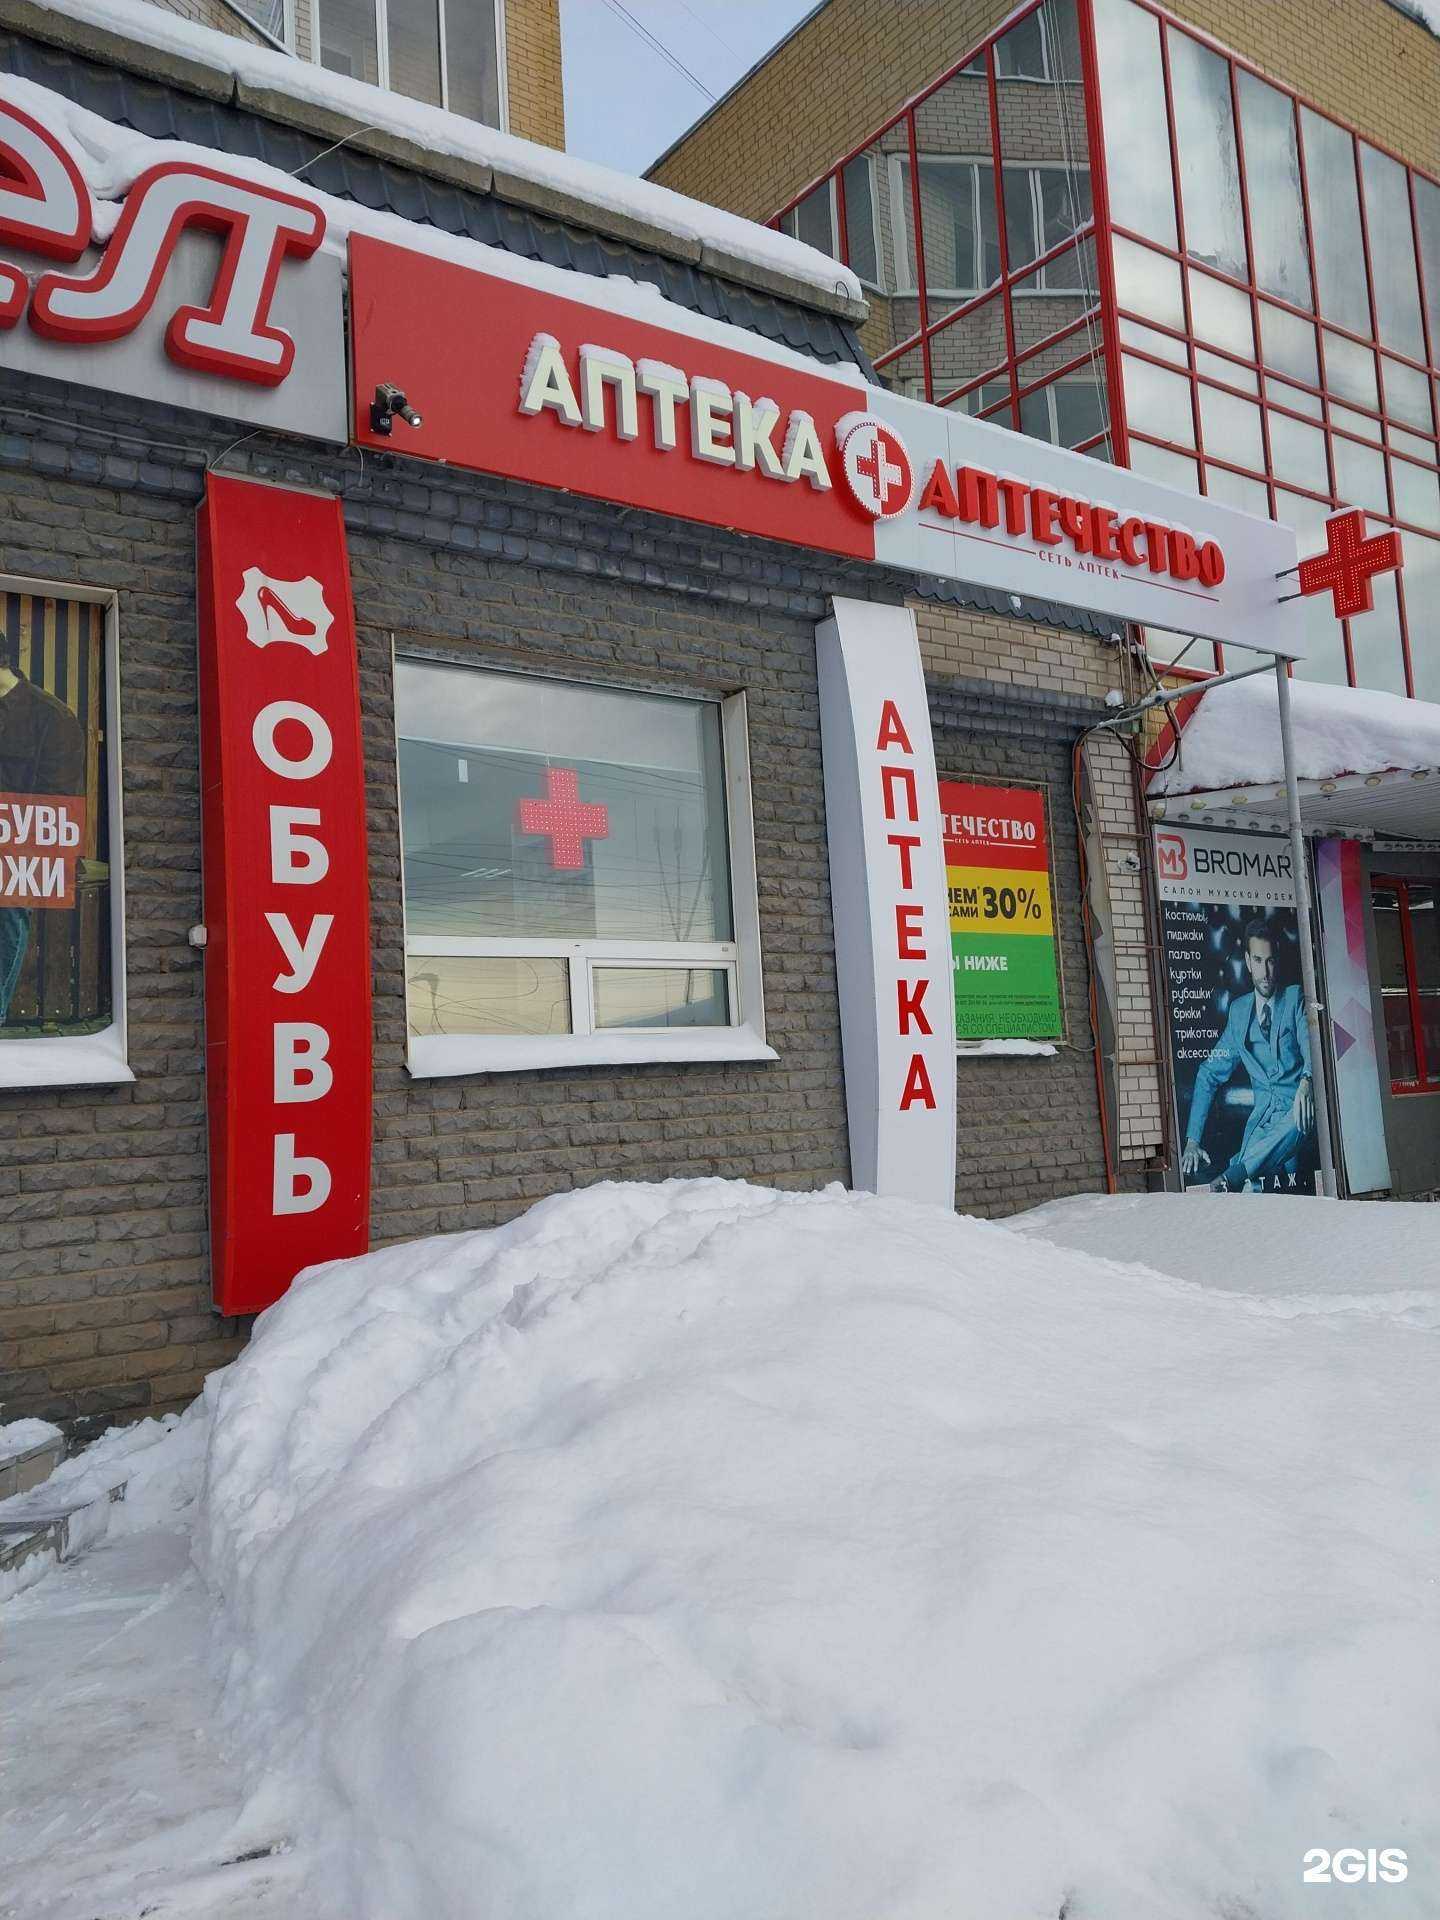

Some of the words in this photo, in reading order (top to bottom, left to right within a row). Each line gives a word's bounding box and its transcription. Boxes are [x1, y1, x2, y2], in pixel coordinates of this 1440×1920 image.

[518, 338, 832, 491] АПТЕКА
[918, 458, 1226, 588] АПТЕЧЕСТВО
[1038, 549, 1072, 567] СЕТЬ
[1077, 560, 1120, 580] АПТЕК
[0, 855, 65, 897] ЖИ
[1163, 886, 1201, 896] САЛОН
[1208, 889, 1260, 899] МУЖСКОЙ
[876, 699, 937, 1110] АПТЕКА
[1166, 929, 1204, 941] пиджаки
[252, 701, 335, 1215] ОБУВЬ
[964, 955, 1008, 971] НИЖЕ
[1168, 950, 1201, 961] пальто
[1170, 967, 1202, 984] куртки
[1173, 1007, 1202, 1022] брюки
[1175, 1027, 1219, 1042] трикотаж
